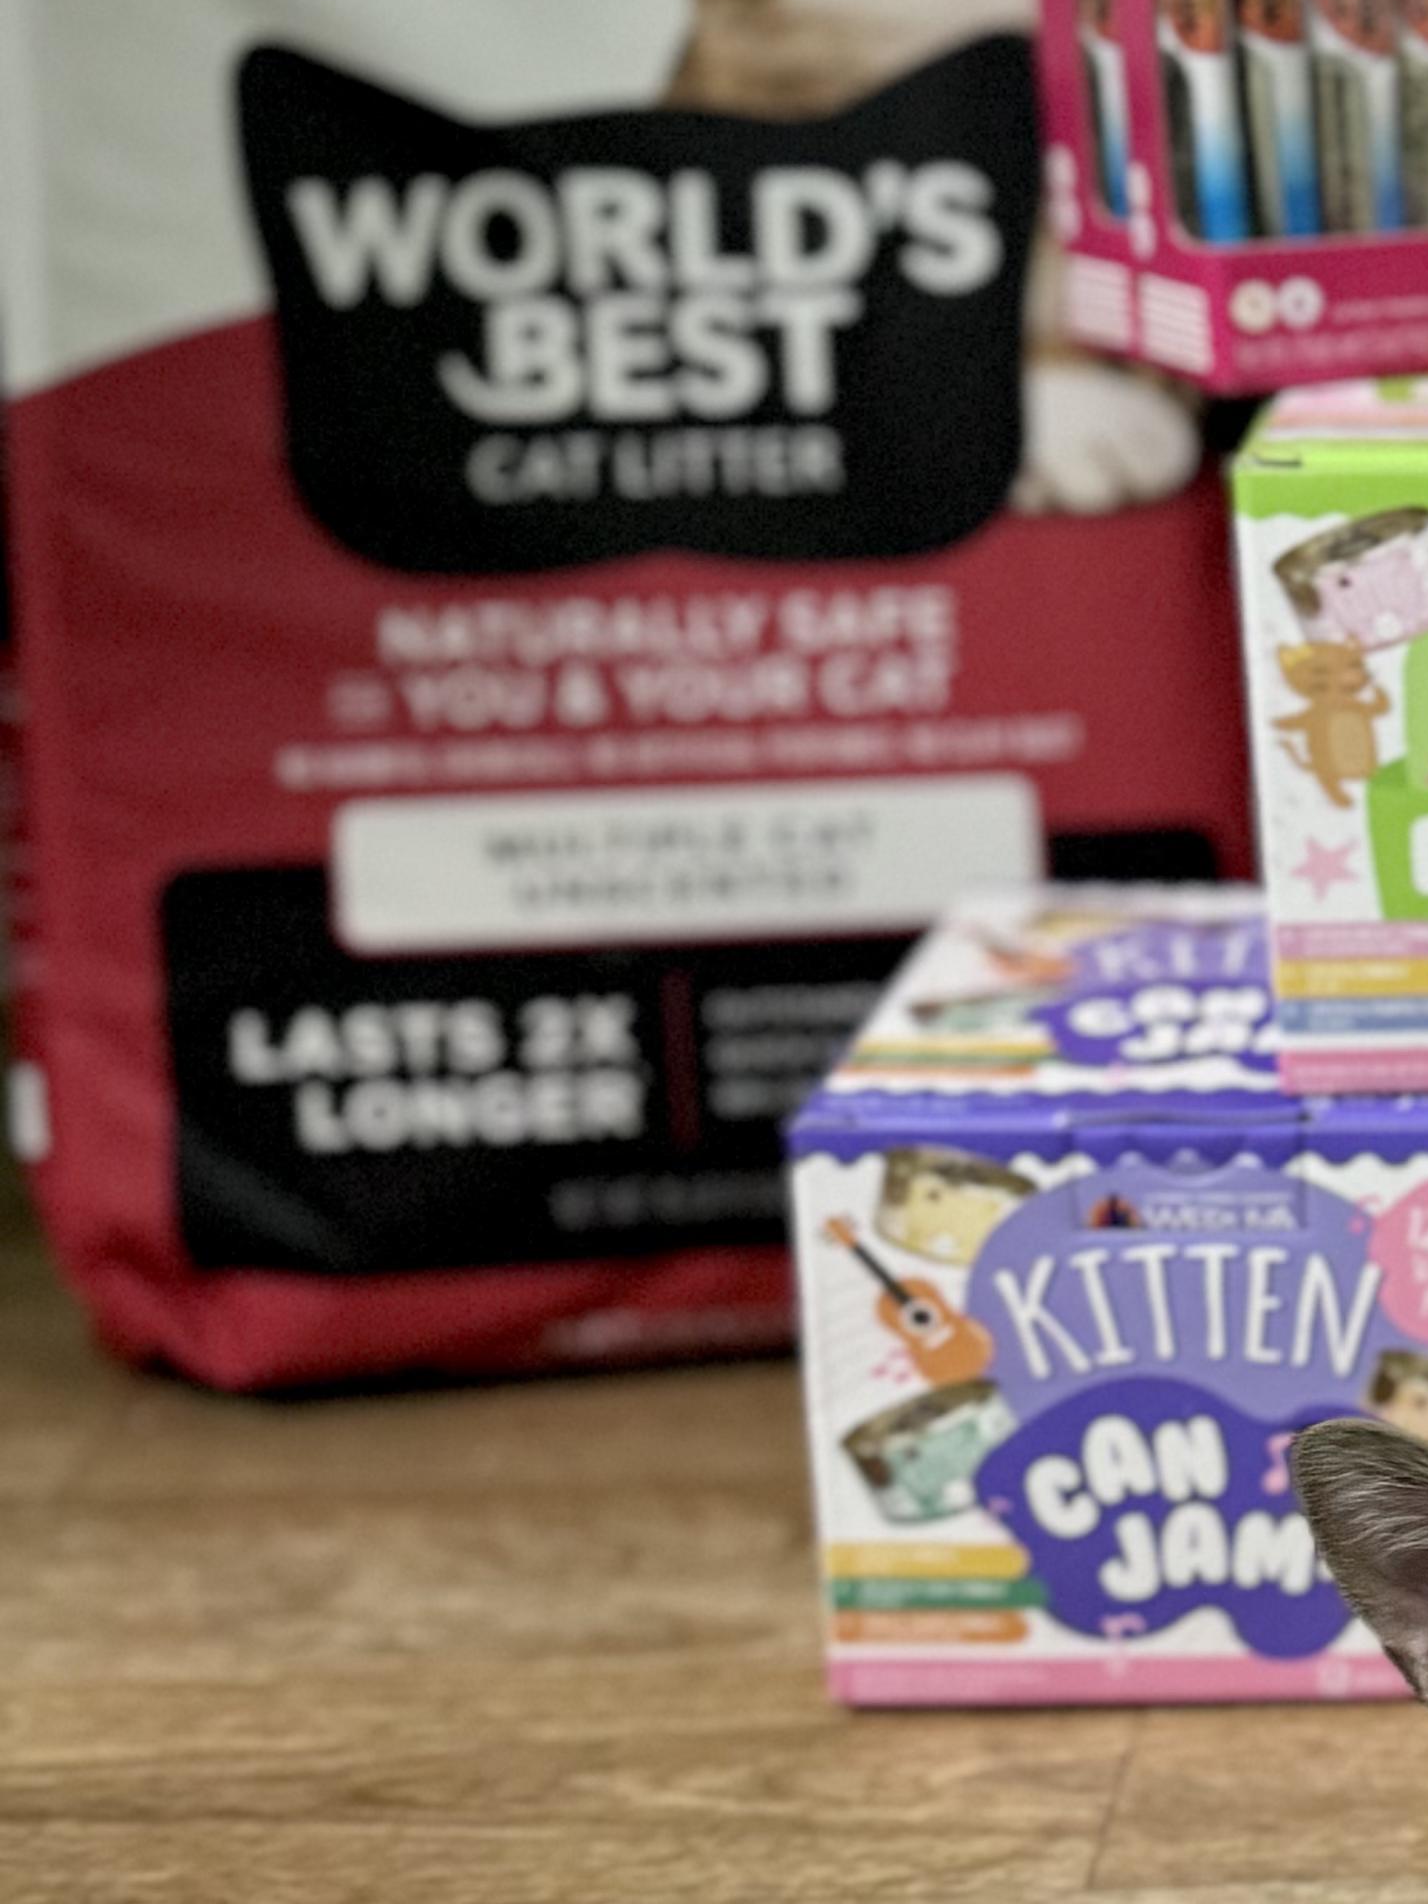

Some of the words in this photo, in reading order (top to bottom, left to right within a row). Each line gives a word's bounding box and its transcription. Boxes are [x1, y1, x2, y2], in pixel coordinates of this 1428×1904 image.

[286, 160, 1001, 307] WORLD'S
[436, 286, 865, 429] BEST
[466, 432, 600, 503] CAT
[613, 421, 846, 501] LITTER
[377, 595, 771, 667] NATURALLY
[777, 583, 956, 652] SAFE
[398, 663, 548, 731] YOU
[613, 654, 811, 724] YOUR
[817, 647, 954, 714] CAT
[227, 996, 505, 1085] LASTS
[294, 1067, 646, 1156] LONGER
[995, 1242, 1381, 1380] KITTEN
[1025, 1414, 1229, 1540] CAN
[1099, 1503, 1334, 1601] JAM
